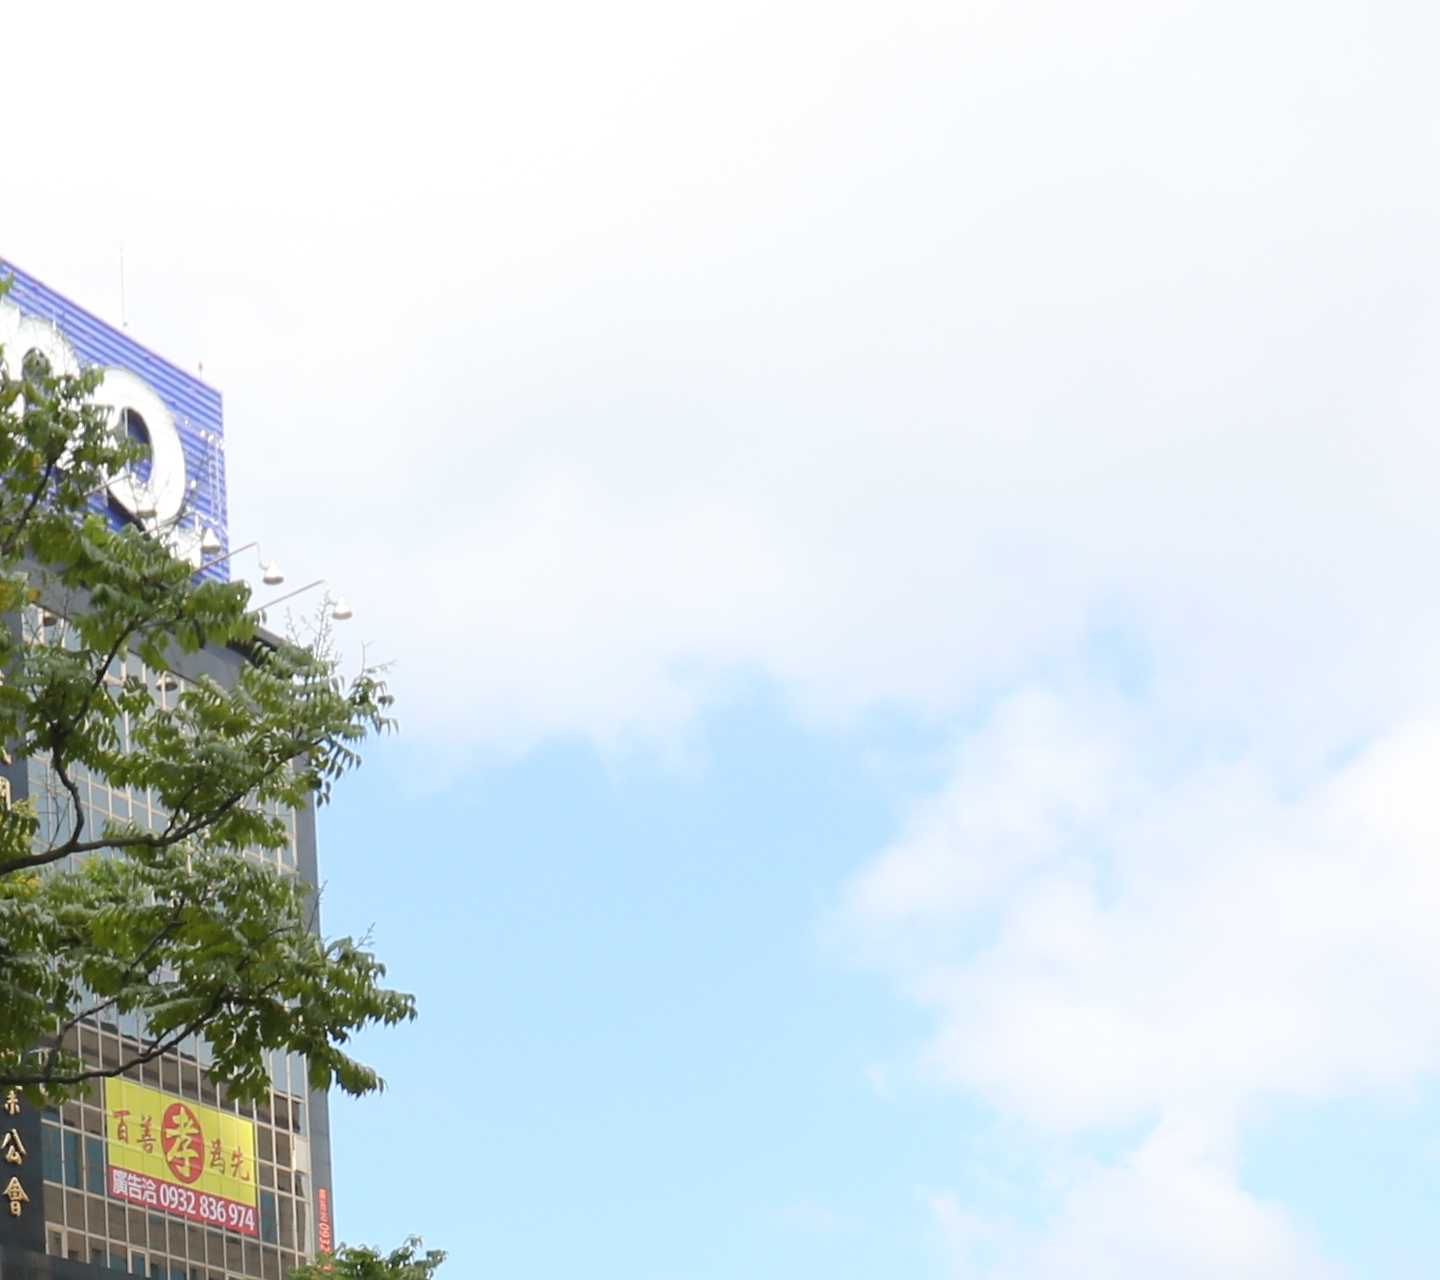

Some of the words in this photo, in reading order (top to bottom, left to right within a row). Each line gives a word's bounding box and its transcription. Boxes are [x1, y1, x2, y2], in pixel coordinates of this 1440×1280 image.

[113, 1169, 157, 1205] 廣告洽
[160, 1184, 196, 1215] 0932
[200, 1196, 226, 1223] 836
[229, 1202, 255, 1231] 974
